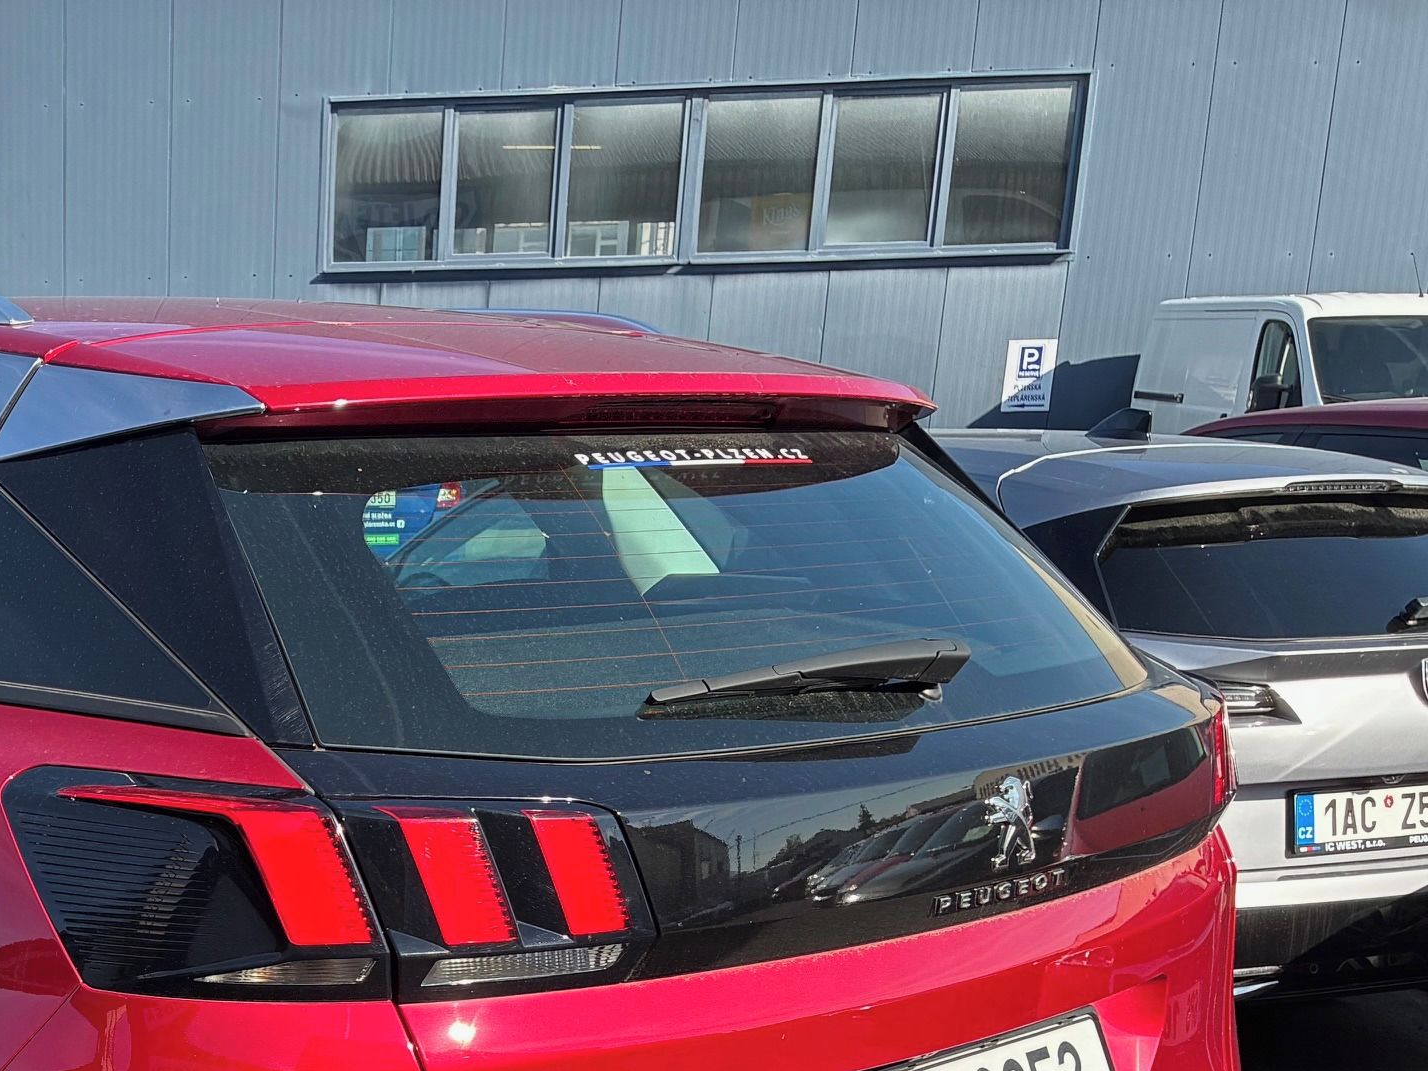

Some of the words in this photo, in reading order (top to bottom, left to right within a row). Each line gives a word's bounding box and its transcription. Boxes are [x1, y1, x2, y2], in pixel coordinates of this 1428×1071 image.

[573, 448, 809, 466] PEUGEOT-PLZEN.CZ
[1324, 796, 1377, 836] 1AC
[1298, 826, 1313, 839] CZ
[1325, 842, 1335, 852] IC
[1336, 840, 1365, 852] WEST,
[1365, 839, 1386, 849] s.r.o.
[933, 868, 1065, 917] PEUGEOT
